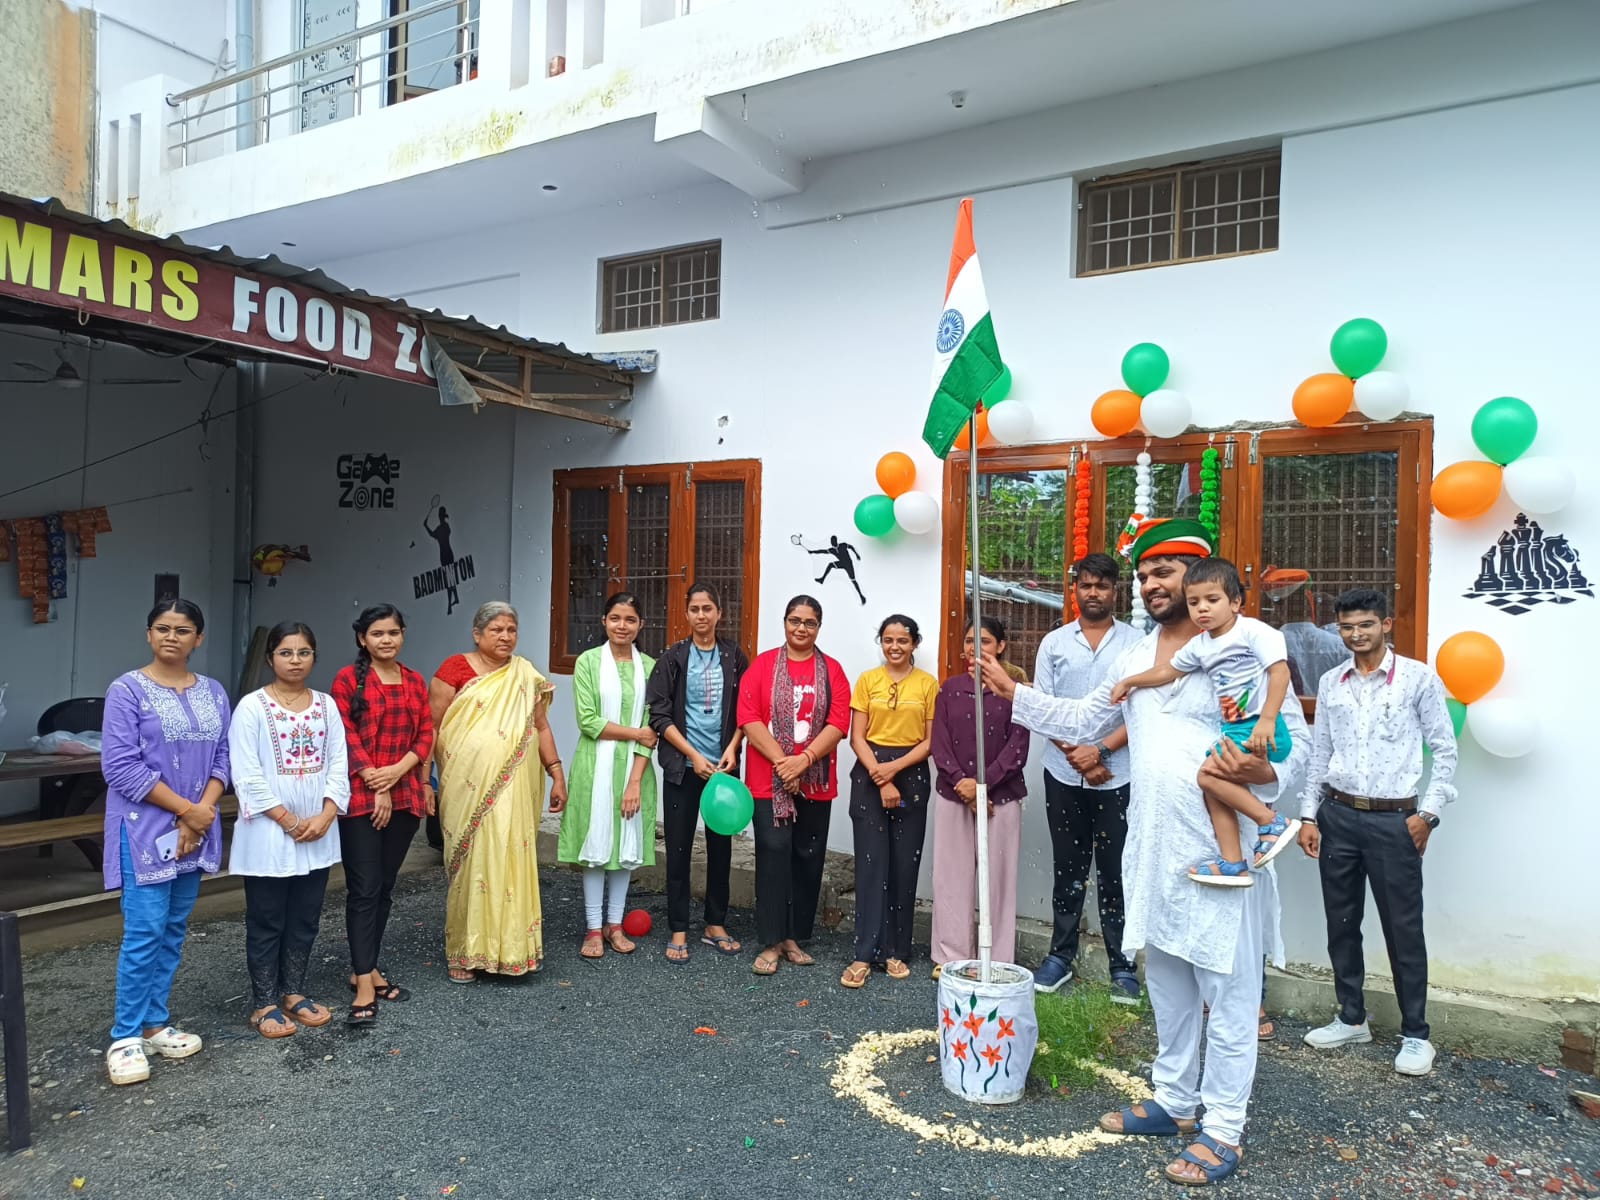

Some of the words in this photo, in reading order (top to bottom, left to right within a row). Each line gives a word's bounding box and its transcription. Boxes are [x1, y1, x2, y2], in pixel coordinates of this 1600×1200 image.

[0, 215, 200, 322] MARS
[232, 276, 372, 361] FOOD
[338, 480, 395, 509] Zone
[412, 553, 475, 599] BADMINTON
